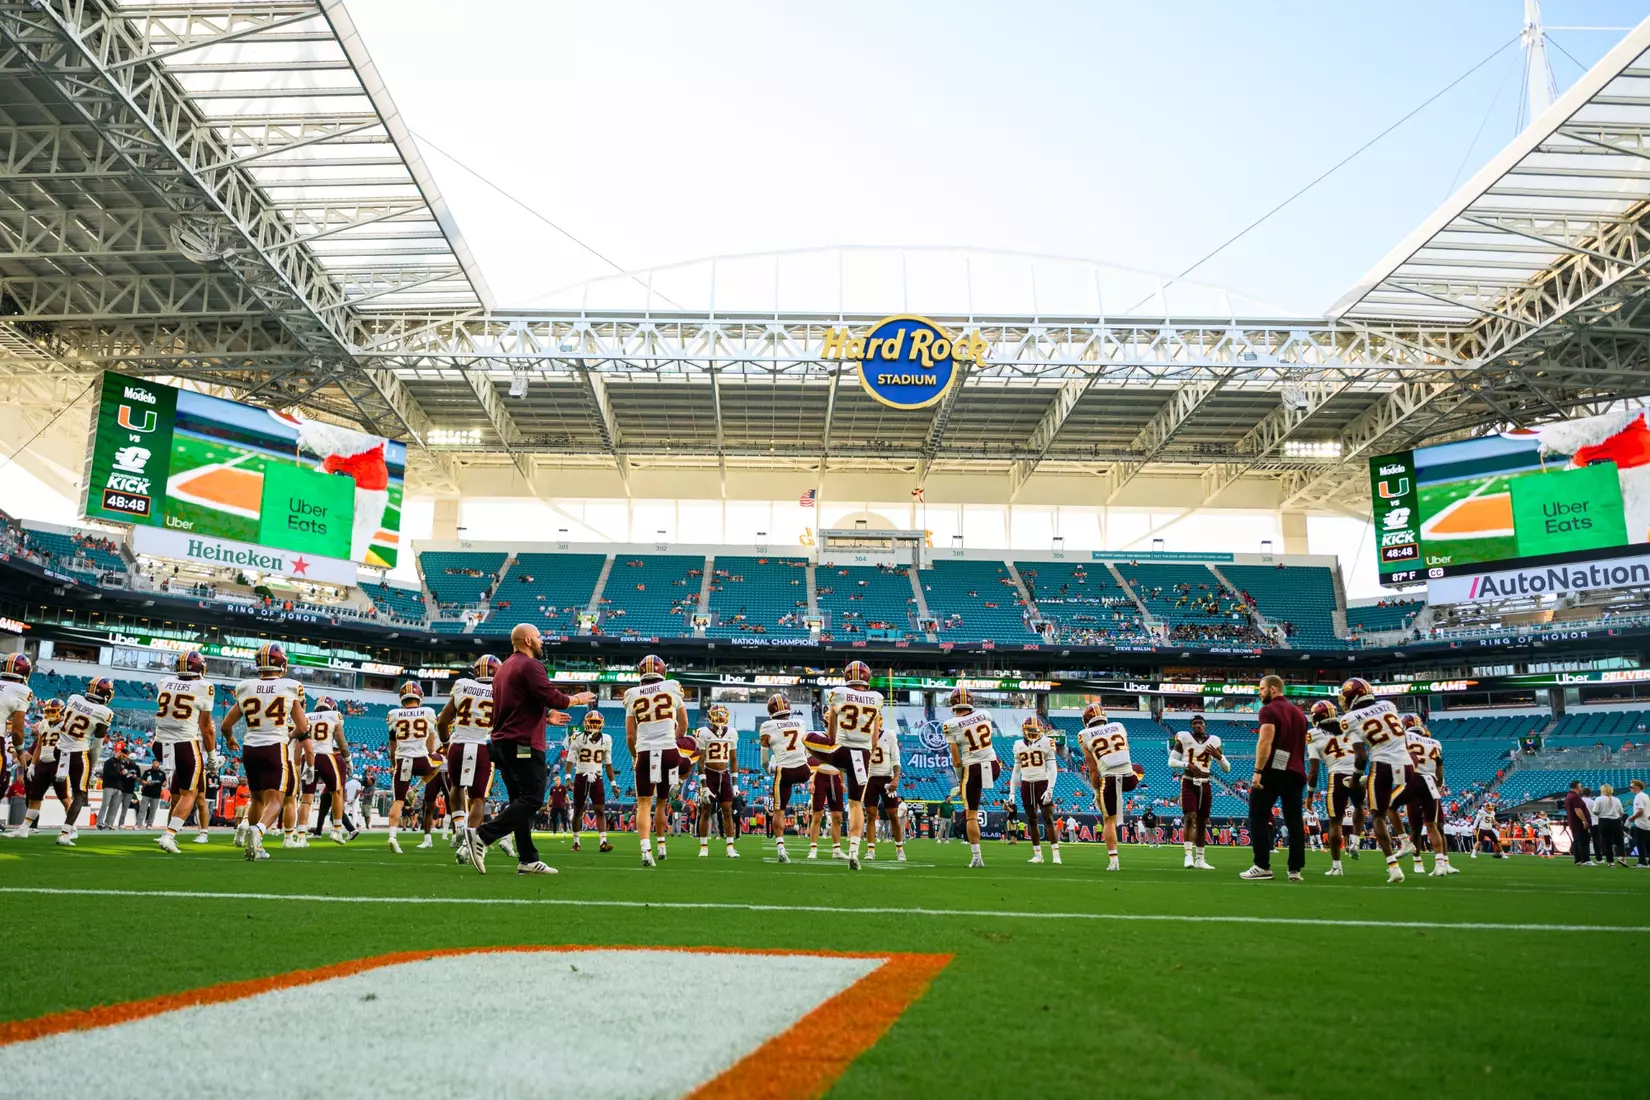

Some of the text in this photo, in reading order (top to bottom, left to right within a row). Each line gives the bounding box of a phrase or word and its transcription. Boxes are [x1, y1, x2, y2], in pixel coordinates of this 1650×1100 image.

[821, 328, 988, 368] Hard Rock
[877, 374, 937, 386] STADIUM
[124, 386, 157, 405] Modelo
[1380, 465, 1405, 476] Modelo
[107, 476, 151, 495] KICK
[107, 495, 146, 512] 48:48
[289, 497, 328, 518] Uber
[1543, 500, 1589, 518] Uber
[166, 515, 194, 530] Uber
[288, 516, 327, 535] Eats
[1545, 518, 1593, 534] Eats
[1382, 532, 1415, 546] KICK
[187, 539, 284, 571] Heineken
[1387, 547, 1413, 558] 48:48
[1426, 555, 1452, 566] Uber
[1409, 571, 1416, 580] F
[1479, 562, 1650, 598] AutoNation
[227, 604, 317, 623] RING OF HONOR
[109, 632, 140, 646] Uber
[150, 638, 203, 651] DELIVERY
[771, 639, 819, 647] CHAMPIONS
[1480, 637, 1510, 646] RING
[1542, 631, 1588, 641] HONOR
[328, 657, 354, 669] Uber
[361, 662, 404, 676] DELIVERY
[418, 669, 450, 679] GAME
[554, 671, 599, 681] DELIVERY
[616, 672, 640, 682] GAM
[165, 682, 191, 691] PETERS
[720, 673, 746, 684] Uber
[754, 676, 801, 685] DELIVERY
[817, 676, 846, 686] GAM
[921, 677, 947, 688] Uber
[956, 679, 1001, 689] DELIVERY
[1019, 680, 1051, 690] GAME
[1124, 681, 1150, 692] Uber
[1159, 683, 1205, 693] DELIVERY
[1222, 685, 1255, 694] GAME
[1430, 680, 1467, 691] GAME
[1555, 673, 1589, 685] Uber
[256, 685, 276, 694] BLUE
[463, 685, 493, 698] WOODFOR
[639, 685, 661, 696] MOORE
[157, 692, 195, 719] 85
[243, 697, 287, 727] 24
[457, 697, 493, 728] 43
[633, 693, 673, 723] 22
[61, 711, 90, 738] 12
[840, 704, 878, 734] 37
[396, 719, 428, 740] 39
[964, 724, 991, 751] 12
[1363, 714, 1405, 747] 26
[784, 730, 798, 751] 7
[1092, 734, 1126, 760] 22
[709, 743, 729, 760] 21
[907, 753, 953, 768] Allstat
[1019, 750, 1044, 768] 20
[1187, 748, 1209, 768] 14
